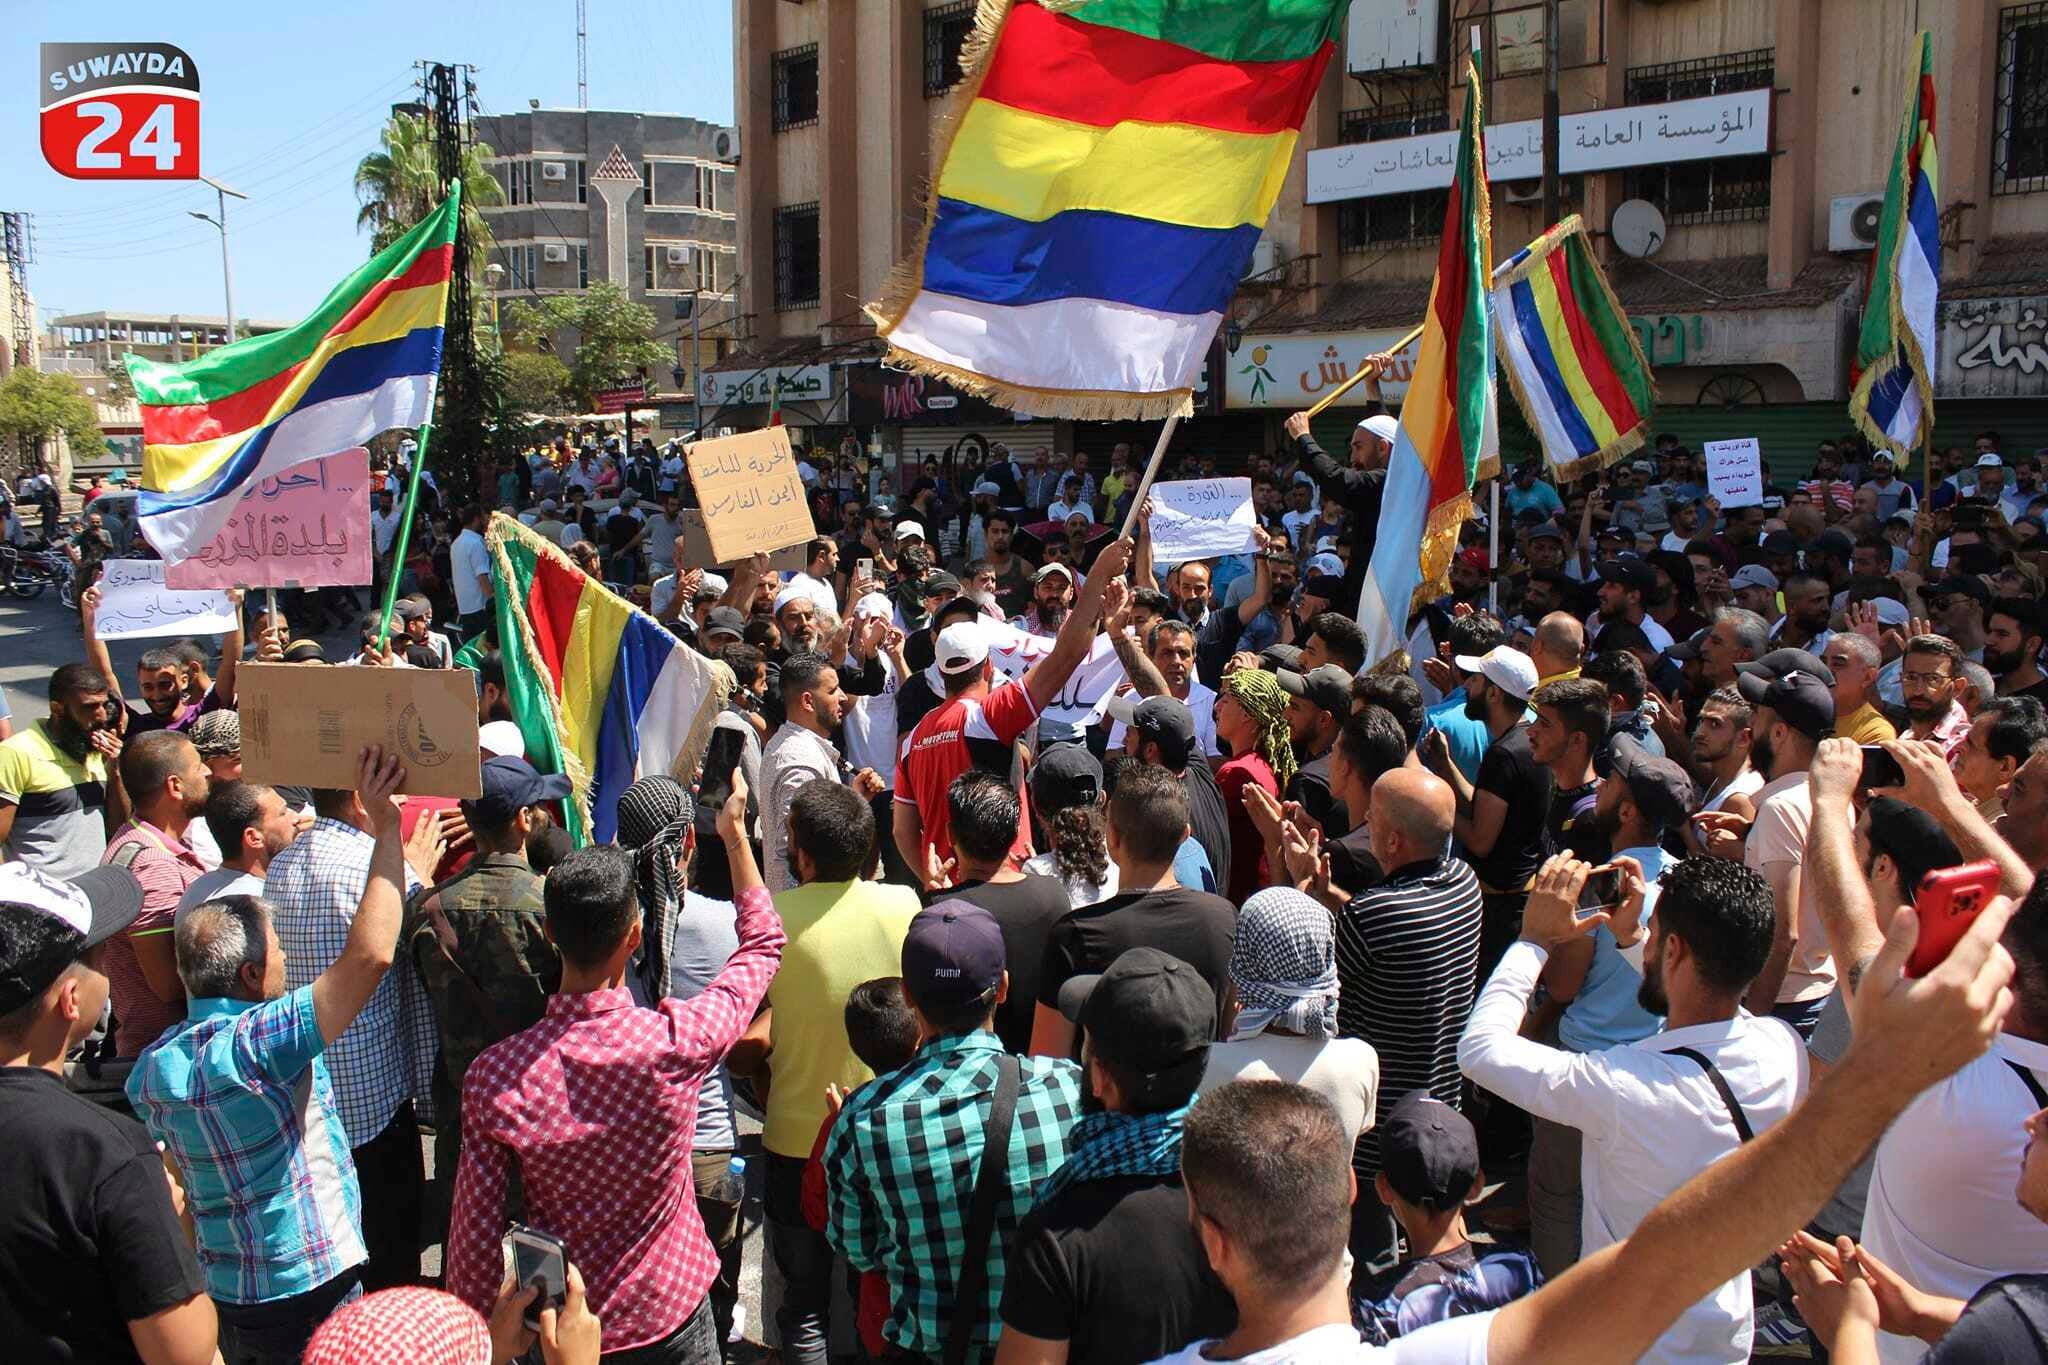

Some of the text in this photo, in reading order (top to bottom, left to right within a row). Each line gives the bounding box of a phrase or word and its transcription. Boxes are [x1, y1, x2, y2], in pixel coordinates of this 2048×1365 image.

[1575, 119, 1642, 149] العامة
[1657, 106, 1753, 144] المؤسسة
[725, 382, 754, 404] ورد
[748, 441, 788, 476] الحرية
[706, 476, 797, 517] أيمن الفارس
[1187, 482, 1225, 504] الثورة
[187, 512, 348, 568] بلدة المزرع
[935, 968, 961, 978] PUMA
